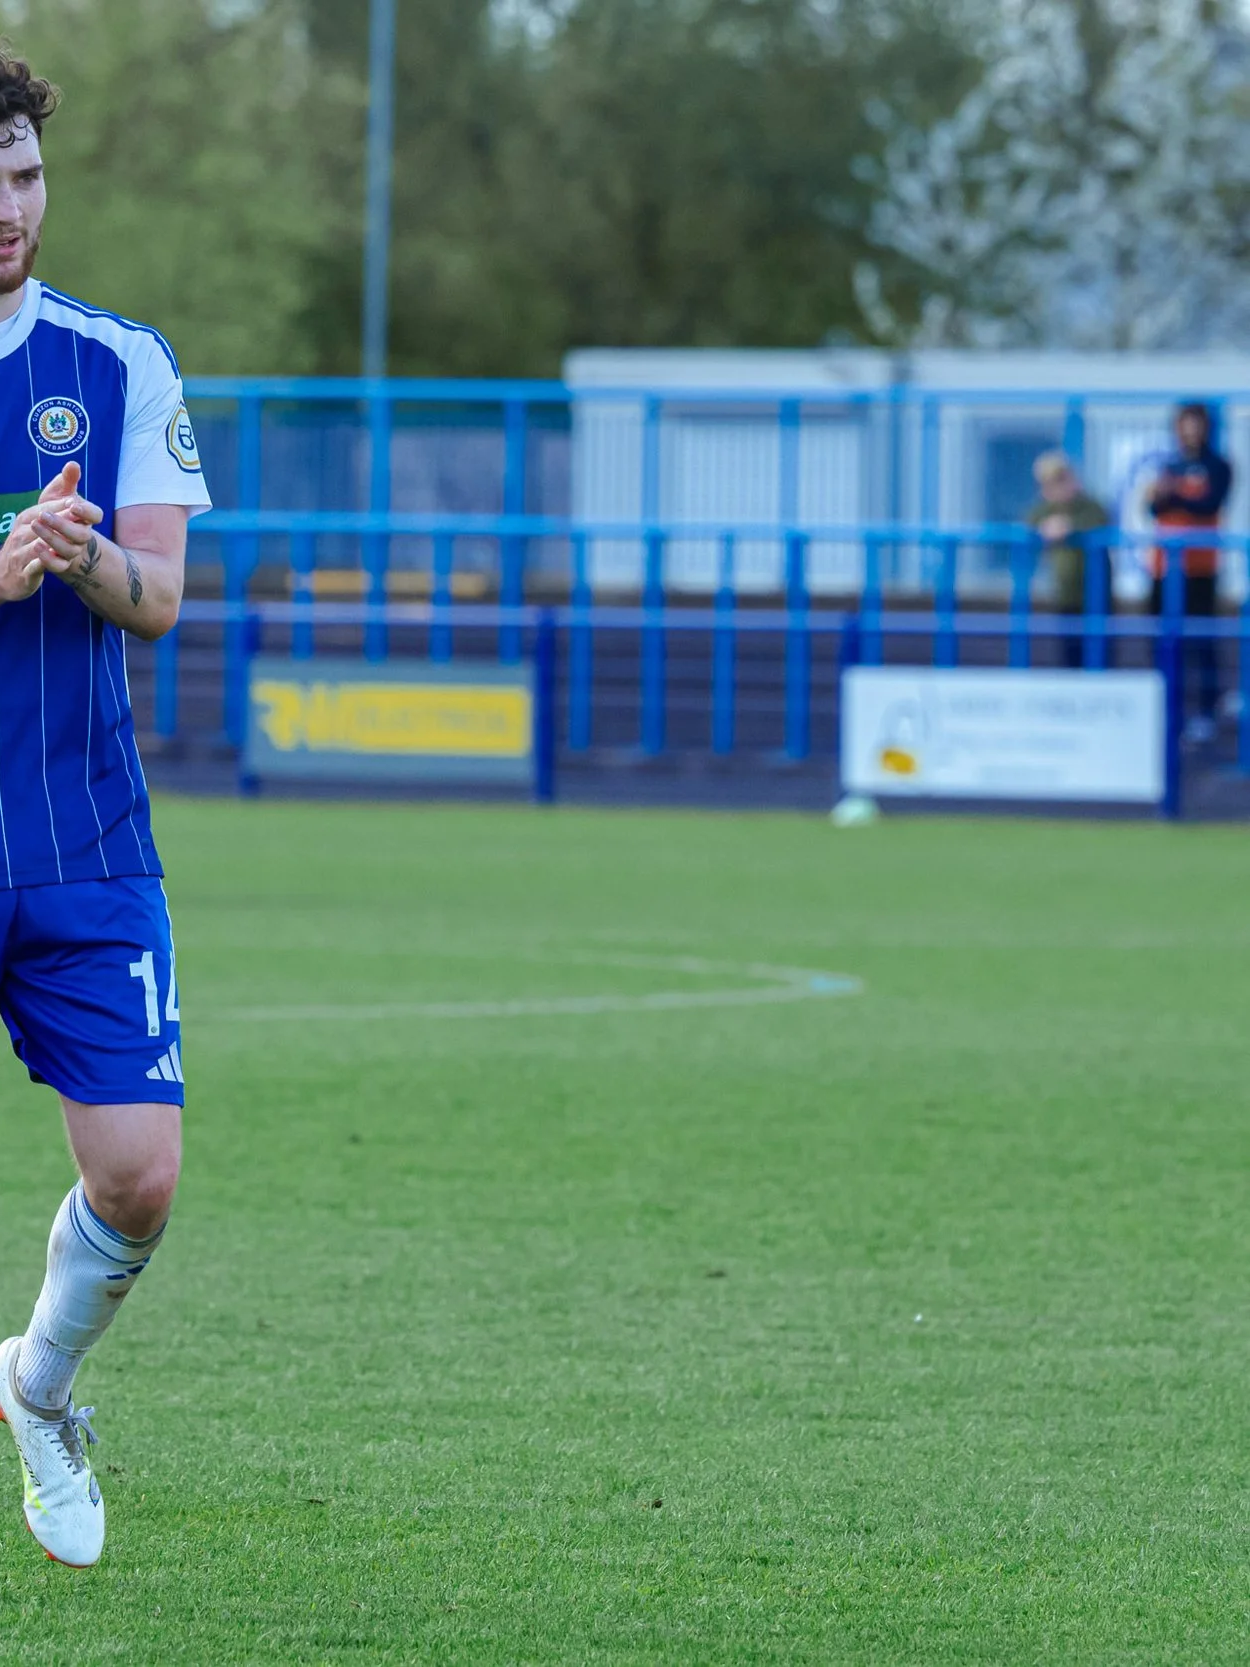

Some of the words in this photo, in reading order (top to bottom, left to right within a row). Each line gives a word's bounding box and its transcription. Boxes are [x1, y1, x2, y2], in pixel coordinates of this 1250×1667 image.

[32, 401, 54, 422] CURZON
[57, 400, 83, 418] ASHTON
[36, 434, 70, 451] FOOTBALL
[72, 430, 85, 446] CLUB
